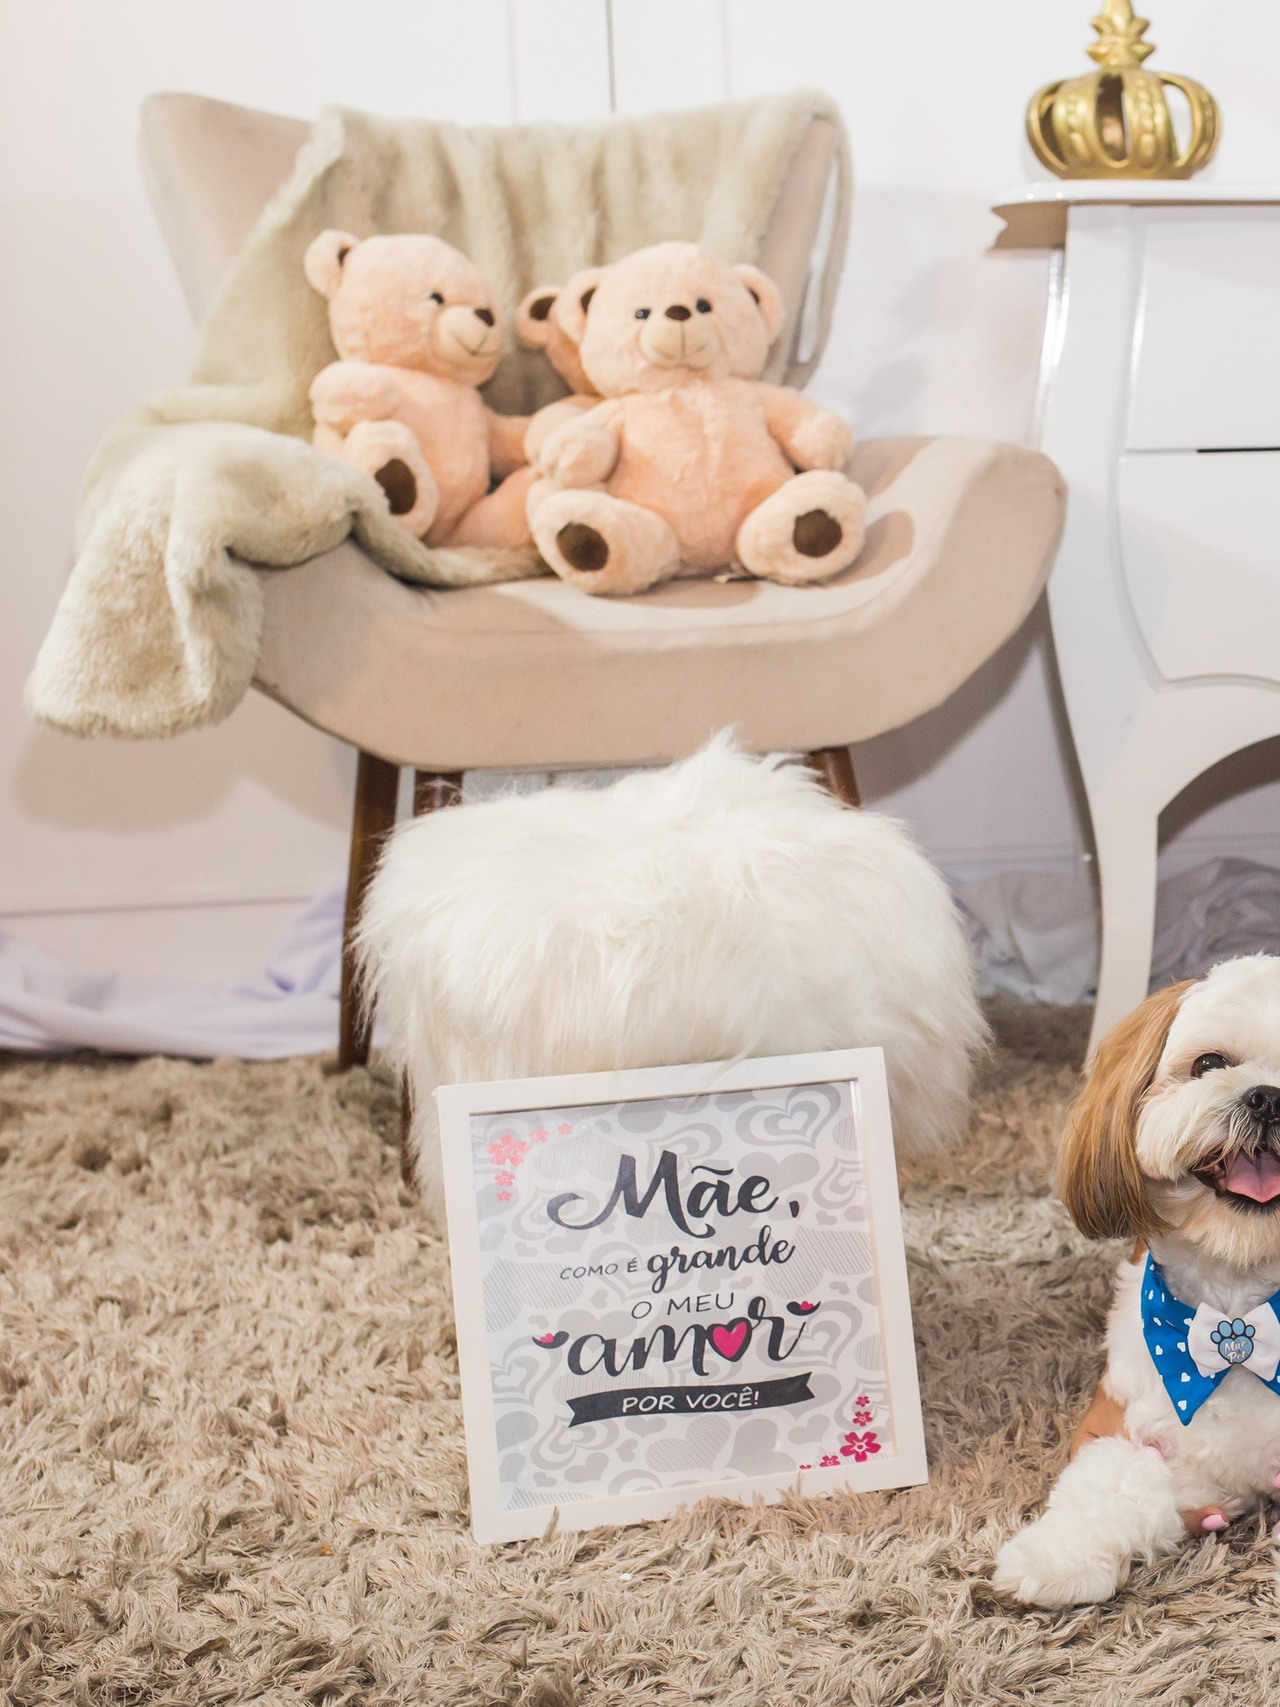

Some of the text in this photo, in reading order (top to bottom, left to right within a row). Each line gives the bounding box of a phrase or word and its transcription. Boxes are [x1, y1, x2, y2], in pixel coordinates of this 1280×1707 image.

[547, 1150, 799, 1238] Mãe,
[560, 1225, 796, 1293] COMO É grande
[567, 1296, 806, 1377] amor
[631, 1292, 735, 1319] O MEU
[622, 1386, 760, 1412] POR VOCÊ!
